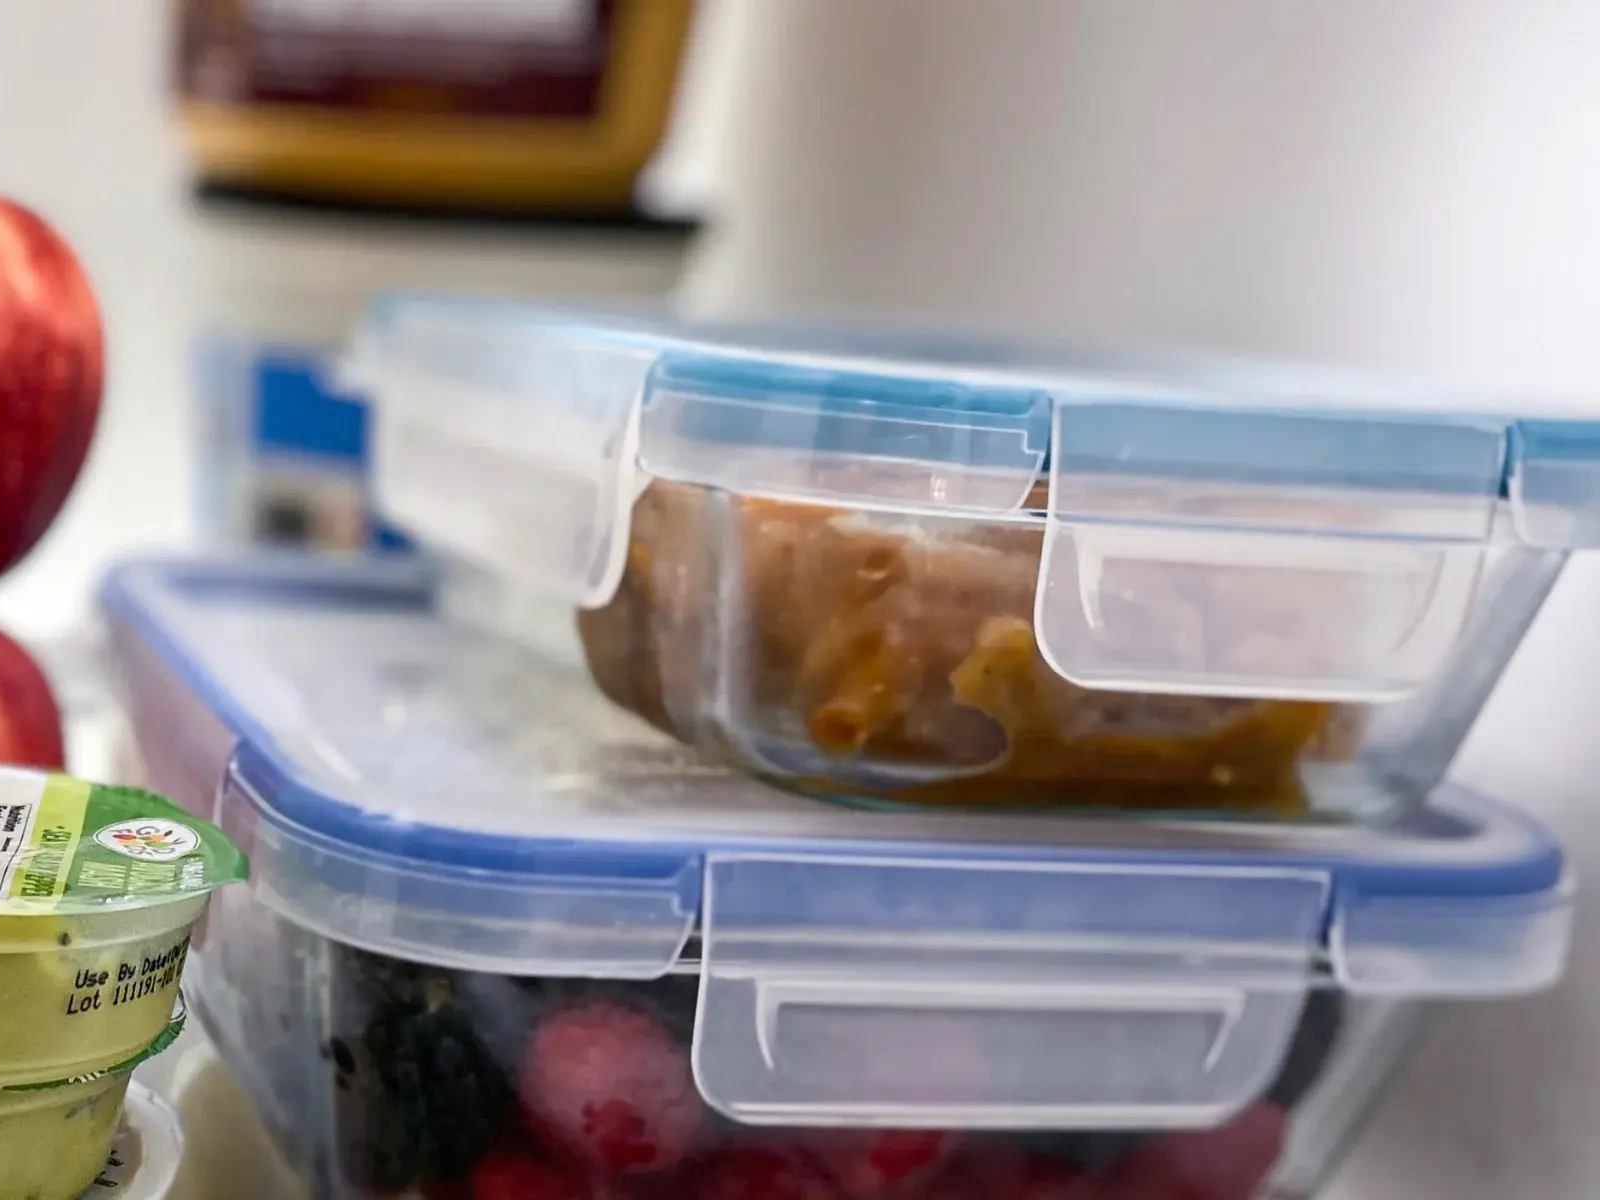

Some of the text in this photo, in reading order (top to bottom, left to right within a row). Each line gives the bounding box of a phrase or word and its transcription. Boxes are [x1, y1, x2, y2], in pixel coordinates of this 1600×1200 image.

[75, 968, 109, 989] Use
[118, 963, 136, 982] By
[67, 989, 101, 1015] Lot
